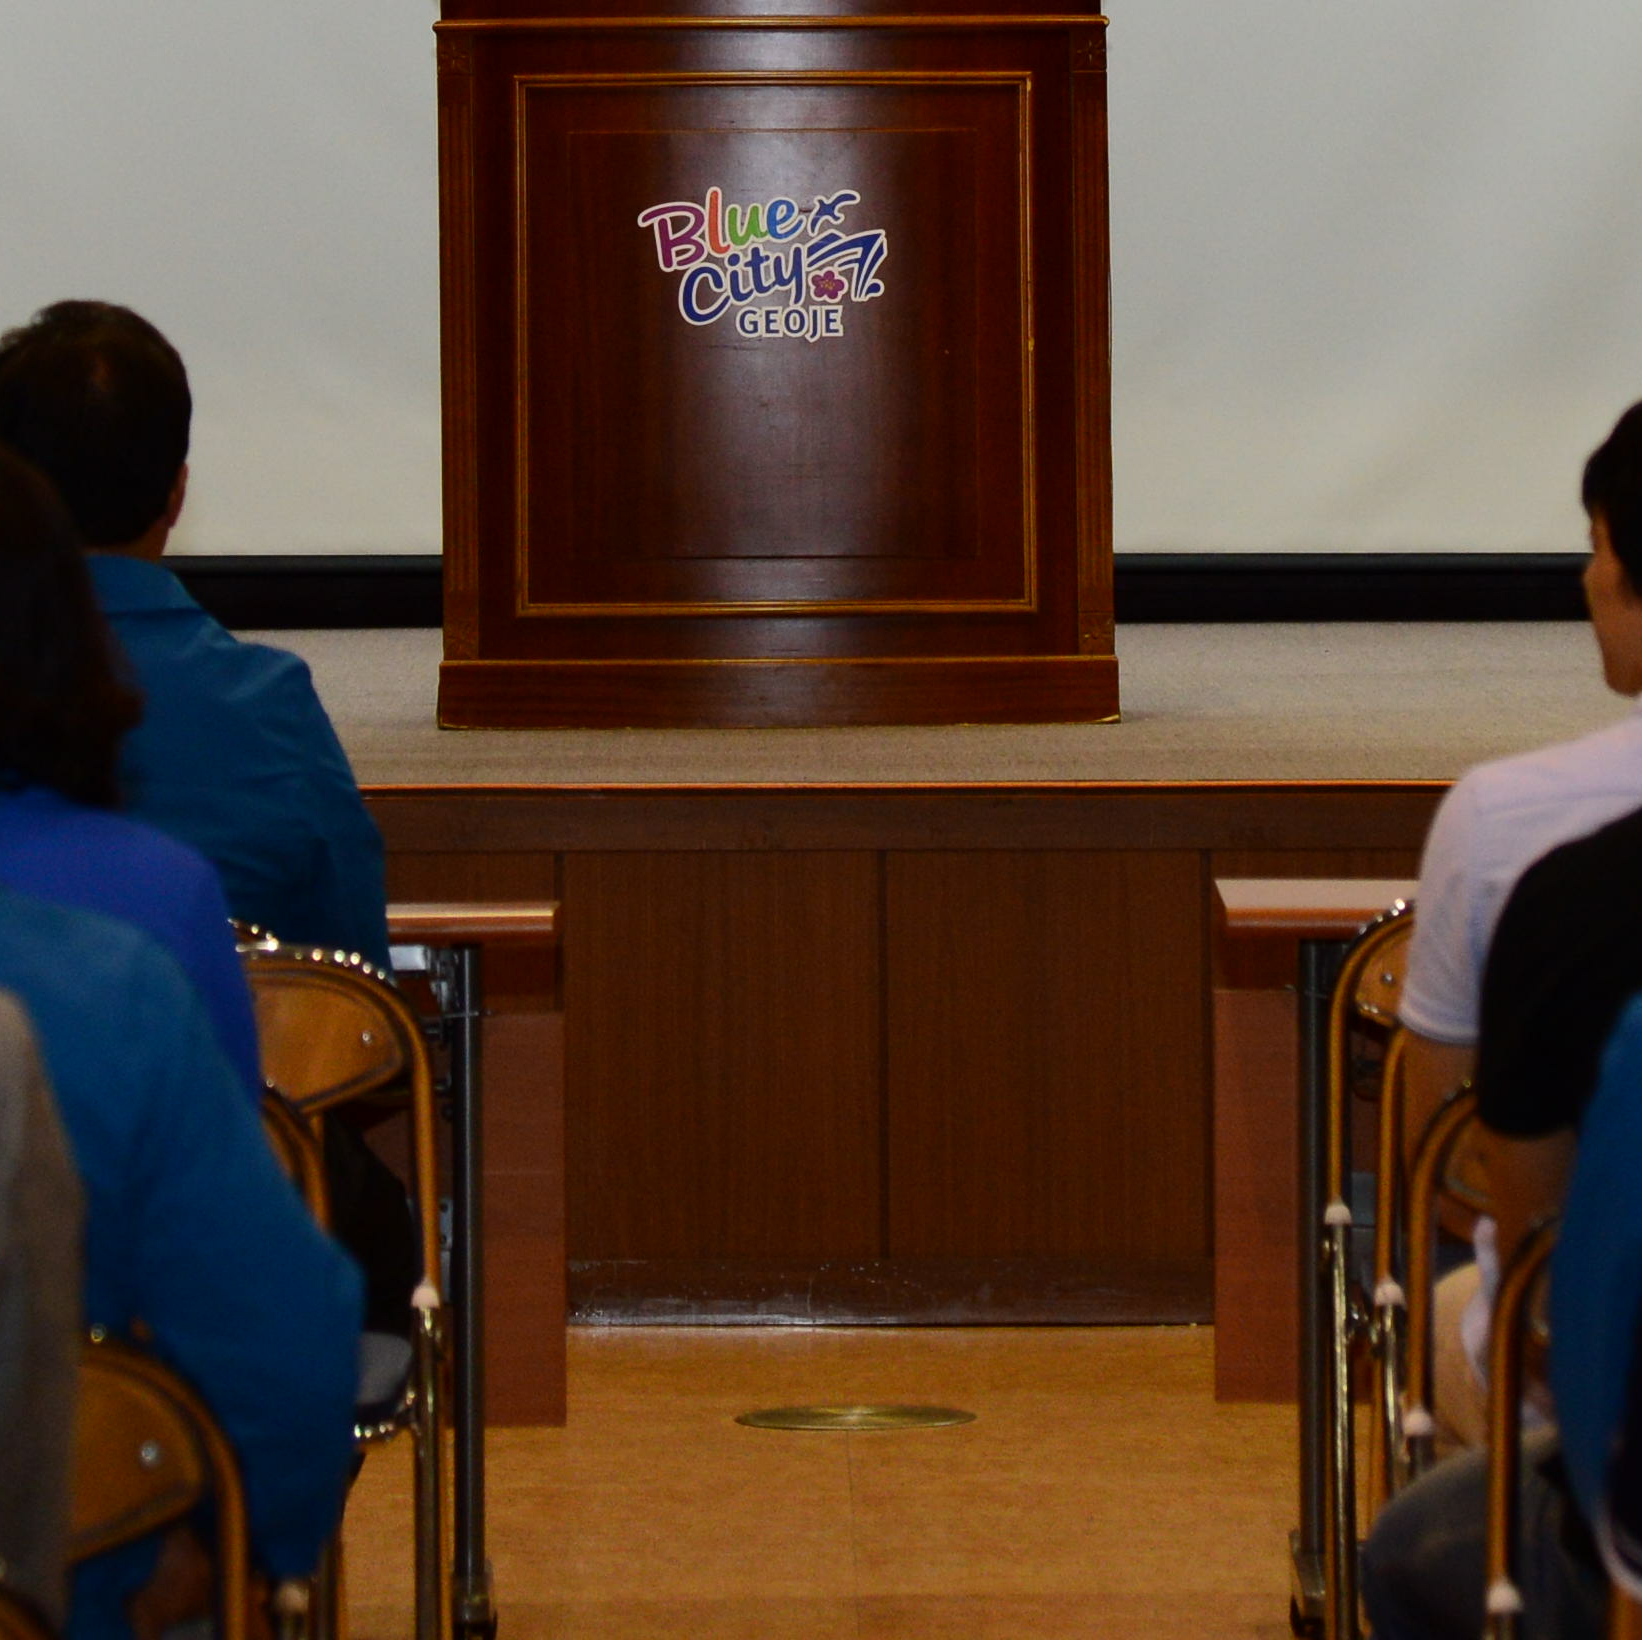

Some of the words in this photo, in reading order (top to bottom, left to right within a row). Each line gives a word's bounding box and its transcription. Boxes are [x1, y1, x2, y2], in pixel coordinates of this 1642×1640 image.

[639, 188, 804, 271] Blue
[680, 244, 805, 324] City
[737, 307, 842, 341] GEOJE
